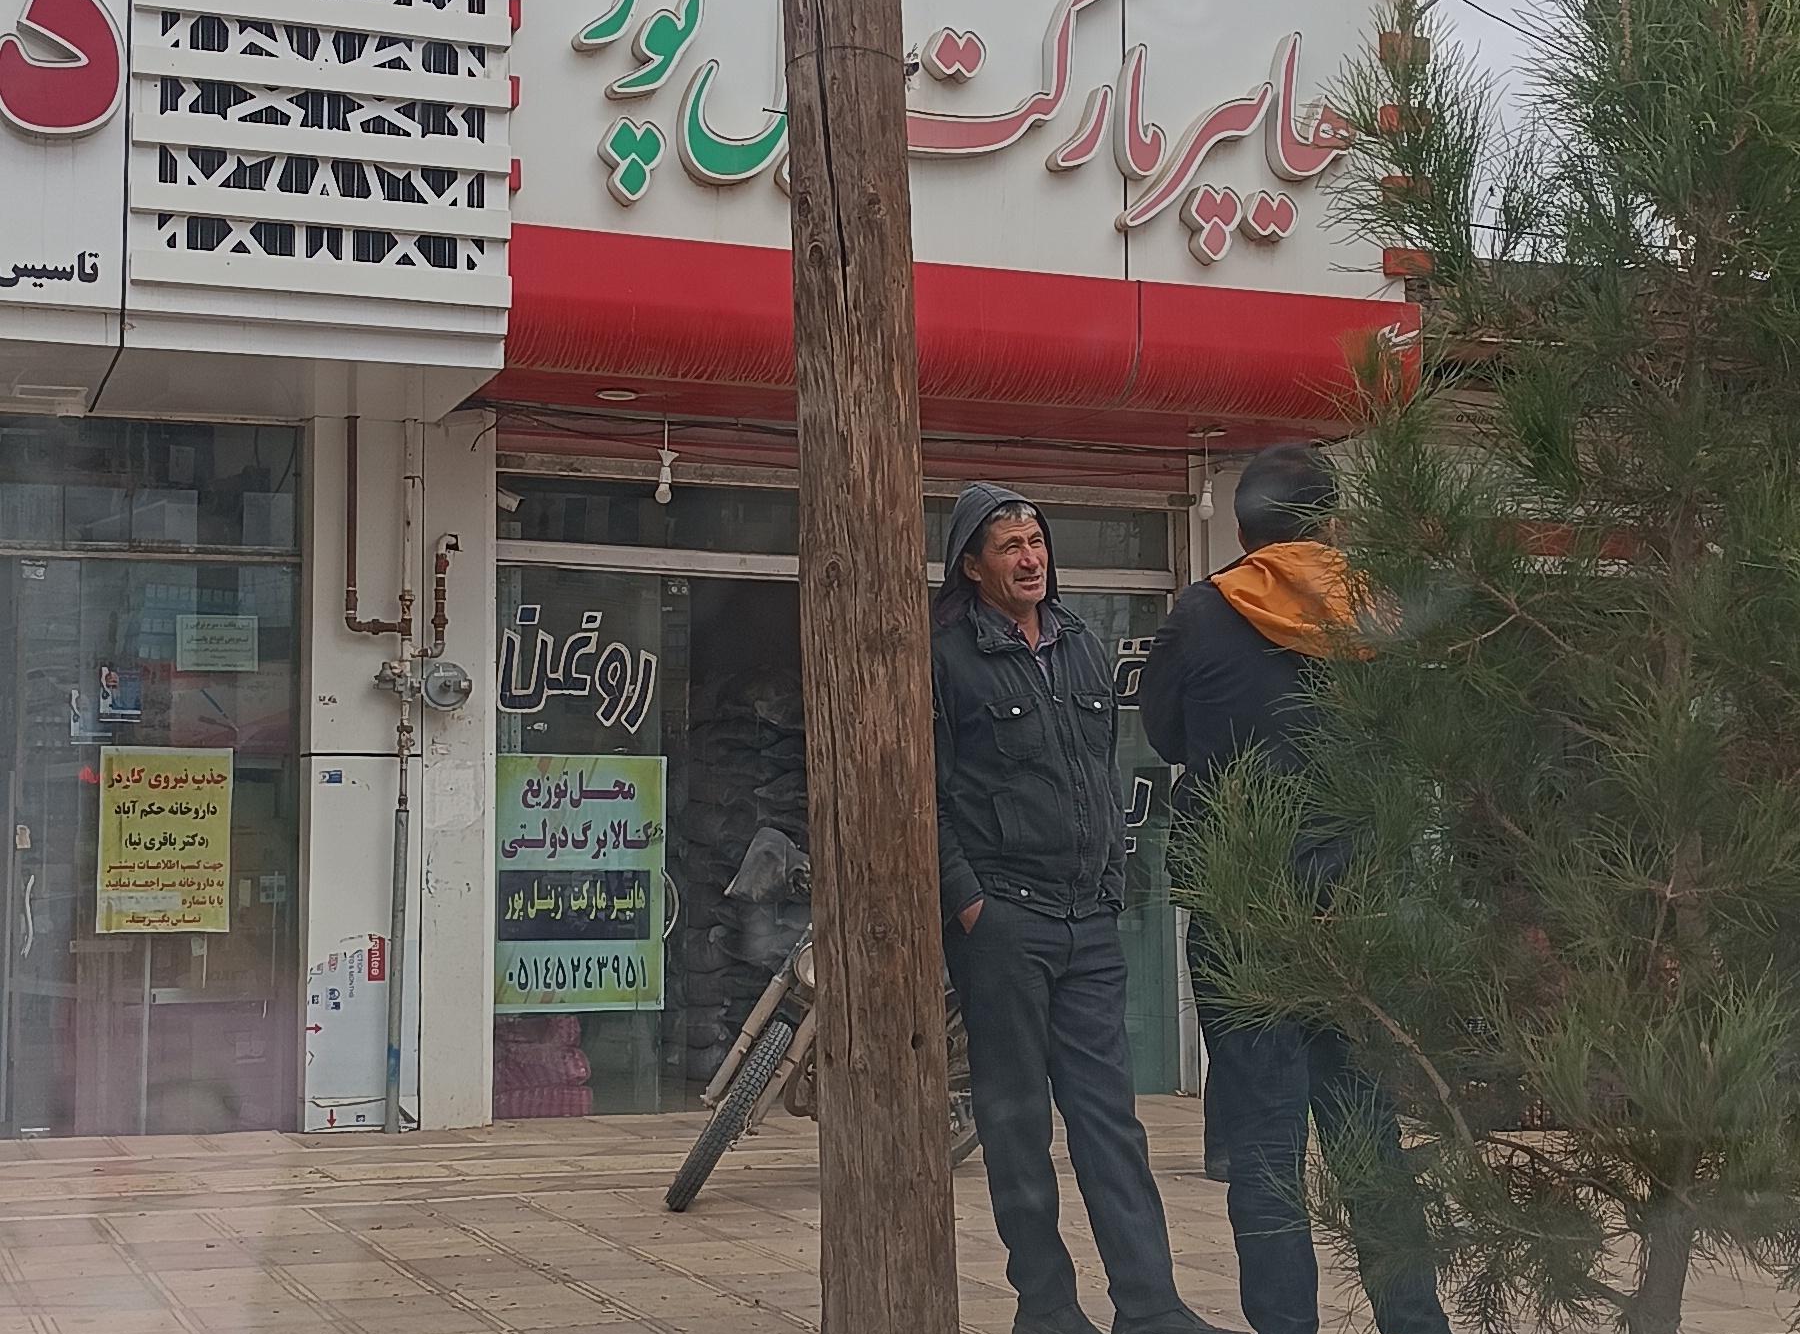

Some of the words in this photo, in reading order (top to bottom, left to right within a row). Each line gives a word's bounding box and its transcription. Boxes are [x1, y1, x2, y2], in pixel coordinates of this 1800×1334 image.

[496, 604, 659, 736] روغن
[148, 768, 189, 789] نیروی
[191, 768, 228, 789] جذب
[521, 770, 569, 809] توزیع
[570, 769, 636, 809] محل
[114, 800, 138, 819] آباد
[140, 802, 166, 820] حکم
[167, 801, 218, 820] داروخانه
[143, 831, 177, 851] باقری
[501, 818, 569, 859] دولتی
[106, 859, 136, 873] بیشتر
[137, 859, 180, 871] اطلاعات
[203, 860, 224, 873] جهت
[131, 878, 177, 891] مراجعه
[178, 877, 215, 891] داروخانه
[216, 879, 225, 891] به
[181, 895, 207, 909] شماره
[170, 913, 201, 926] تماس
[370, 934, 380, 976] rantee
